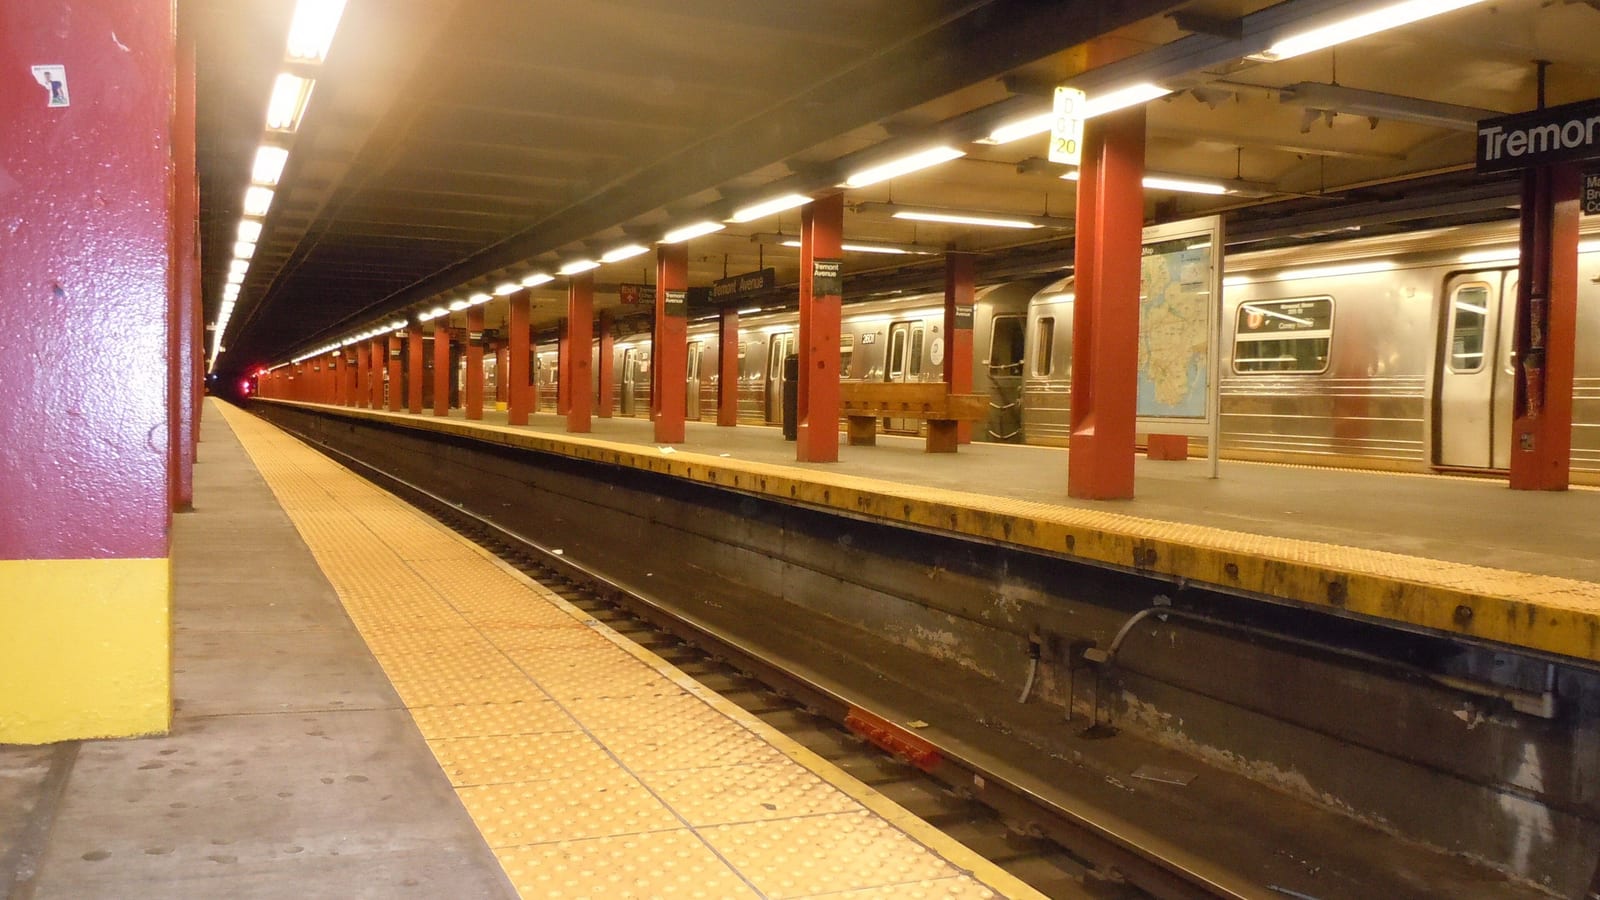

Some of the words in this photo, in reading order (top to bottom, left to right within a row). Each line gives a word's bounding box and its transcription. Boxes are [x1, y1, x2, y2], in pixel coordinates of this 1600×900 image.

[1056, 138, 1075, 154] 20
[1142, 247, 1154, 255] Map
[815, 263, 839, 271] Tremont
